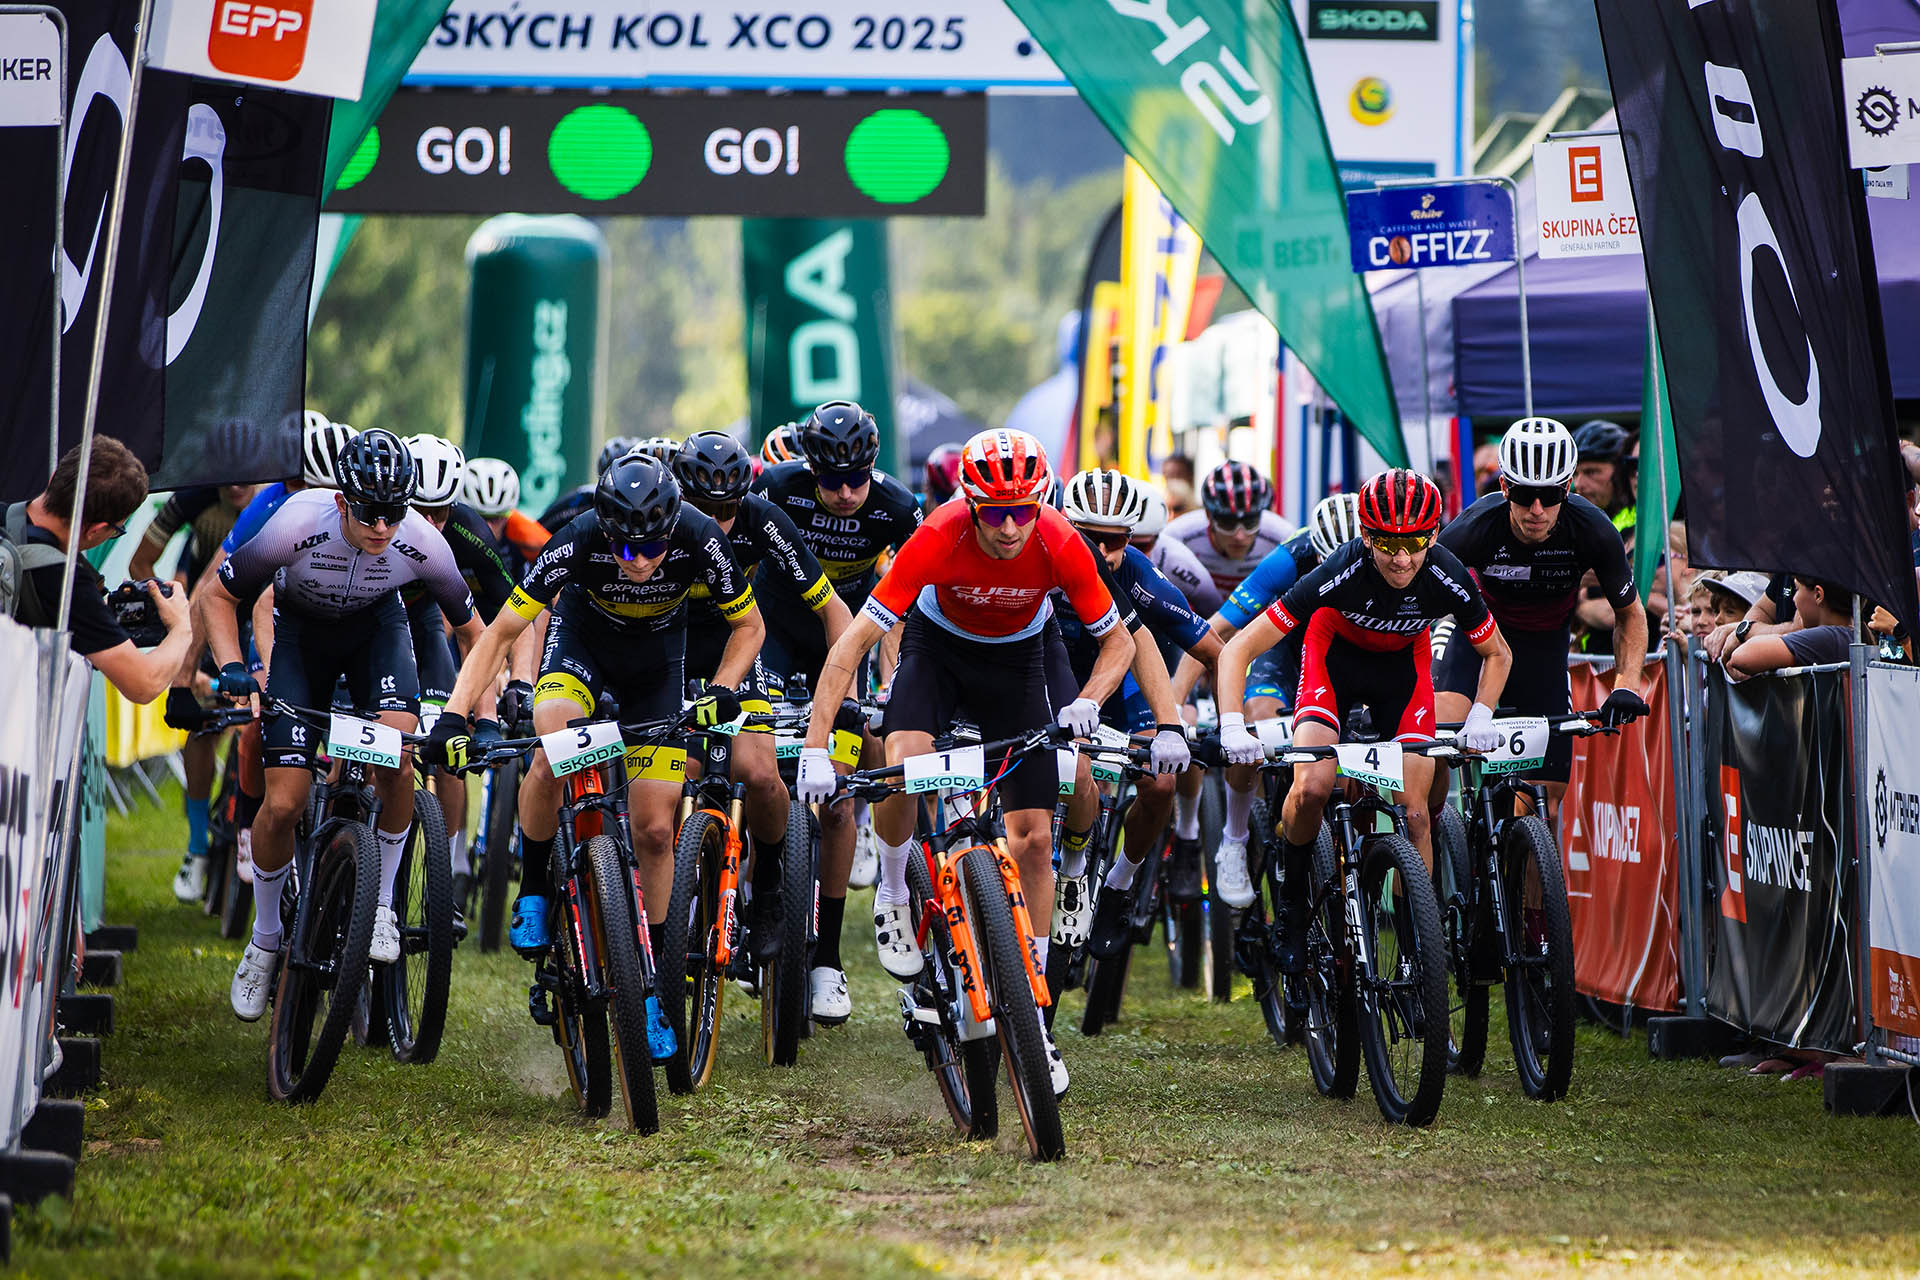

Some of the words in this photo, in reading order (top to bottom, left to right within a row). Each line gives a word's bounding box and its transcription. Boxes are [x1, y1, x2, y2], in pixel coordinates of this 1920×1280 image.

[220, 1, 303, 41] EPP
[612, 14, 710, 51] KOL
[728, 14, 832, 50] XCO
[853, 17, 966, 51] 2025
[416, 125, 511, 176] GO!
[703, 125, 800, 176] GO!
[1380, 223, 1421, 234] CAFFEINE
[1425, 221, 1446, 230] AND
[1449, 219, 1478, 229] WATER
[1542, 216, 1604, 239] SKUPINA
[1609, 213, 1637, 235] ČEZ
[1593, 240, 1621, 251] PARTNER
[811, 512, 861, 533] BMD
[293, 531, 331, 552] LAZER
[391, 539, 428, 564] LAZER
[542, 541, 575, 565] Energy
[786, 549, 808, 582] Energy
[951, 585, 1041, 597] CUBE
[360, 725, 376, 746] 5
[573, 727, 592, 749] 3
[1510, 730, 1526, 756] 6
[627, 756, 654, 769] BMD
[670, 759, 687, 772] BM
[939, 754, 950, 772] 1
[1364, 747, 1380, 771] 4
